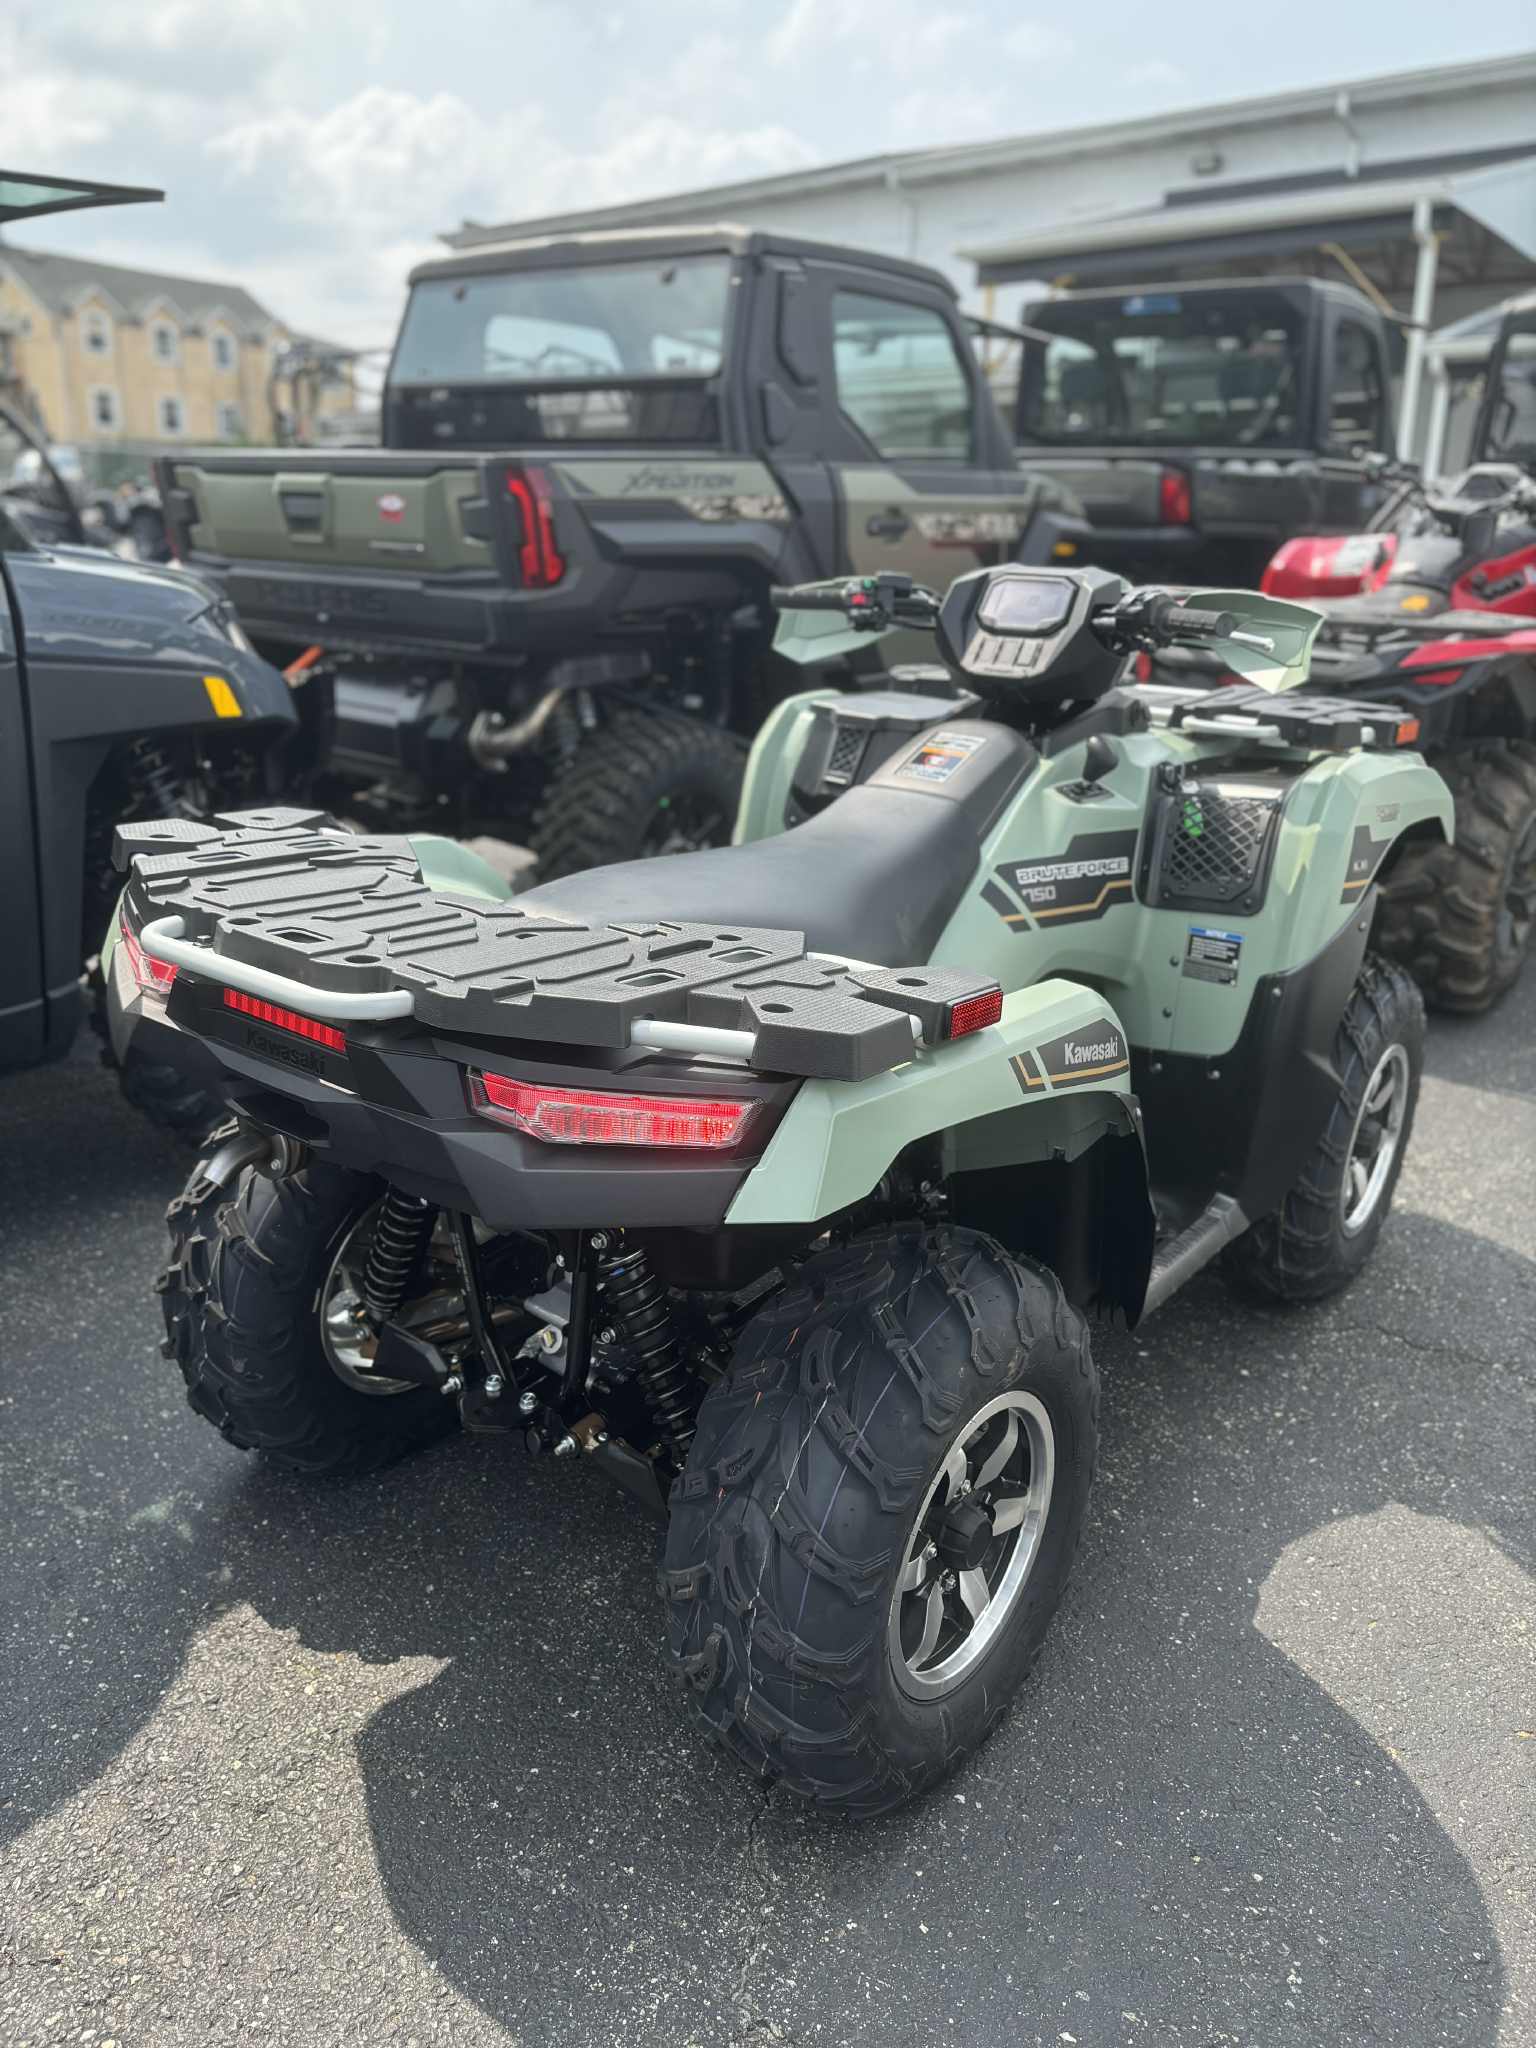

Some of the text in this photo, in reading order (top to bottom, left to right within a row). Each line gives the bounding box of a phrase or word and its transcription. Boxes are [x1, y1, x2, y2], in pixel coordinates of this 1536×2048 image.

[1022, 885, 1057, 902] 750
[246, 1027, 326, 1076] Kawasaki
[1064, 1035, 1119, 1066] Kawasaki
